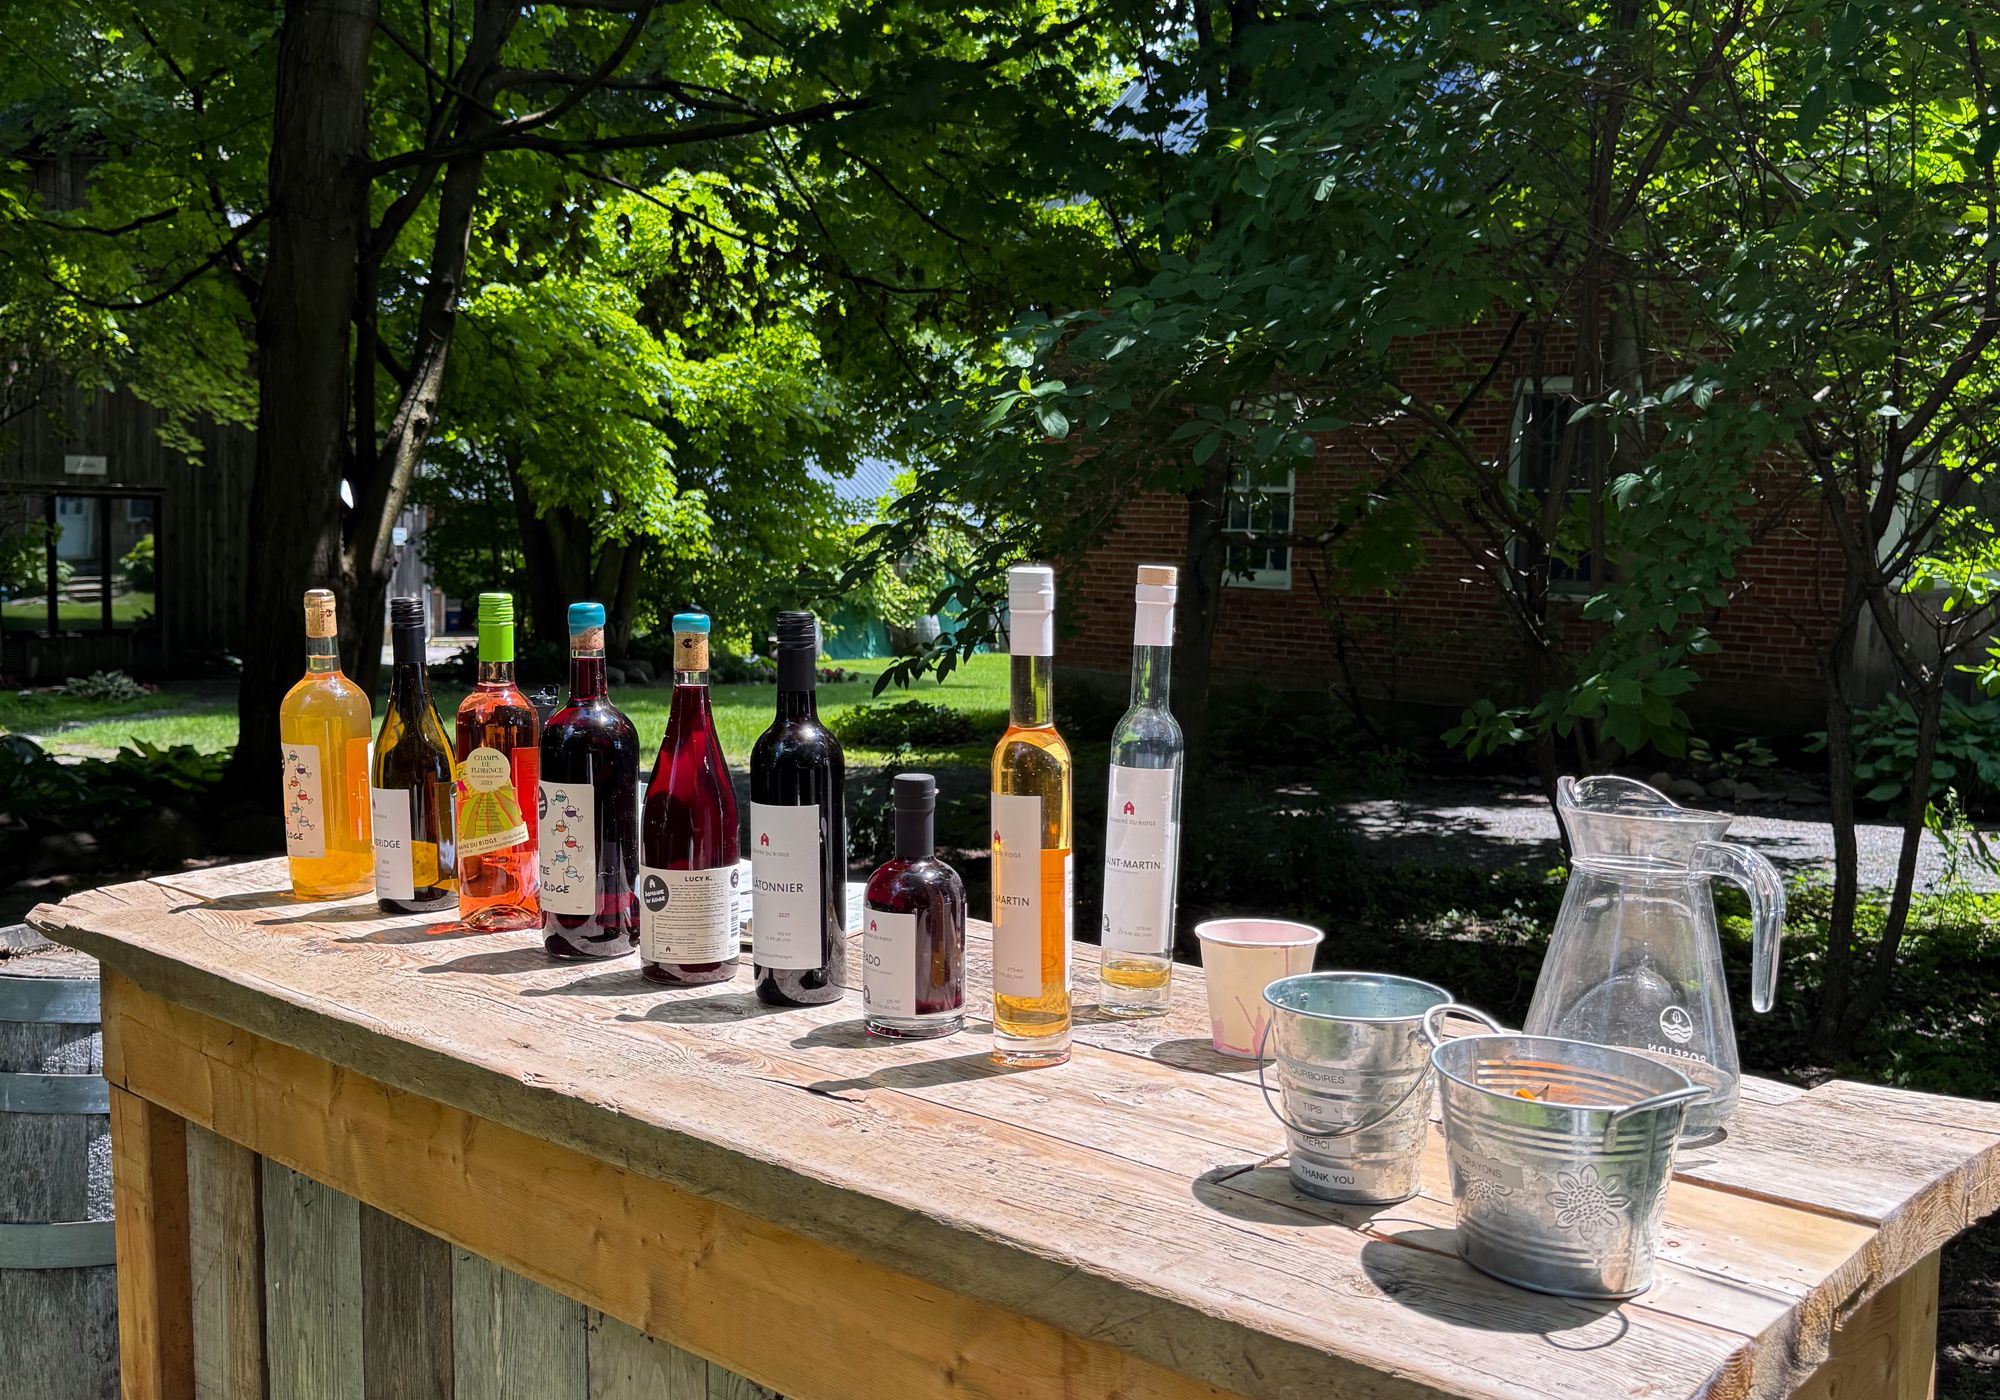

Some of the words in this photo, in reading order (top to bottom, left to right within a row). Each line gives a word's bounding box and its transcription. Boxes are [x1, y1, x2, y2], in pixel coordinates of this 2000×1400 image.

[473, 754, 500, 762] CHAMPS
[543, 881, 570, 894] RIDGE
[1303, 1102, 1322, 1115] TIPS
[1302, 1134, 1330, 1150] MERCI
[1461, 1154, 1503, 1179] CRAYONS
[1301, 1165, 1330, 1182] THANK
[1332, 1174, 1355, 1185] YOU
